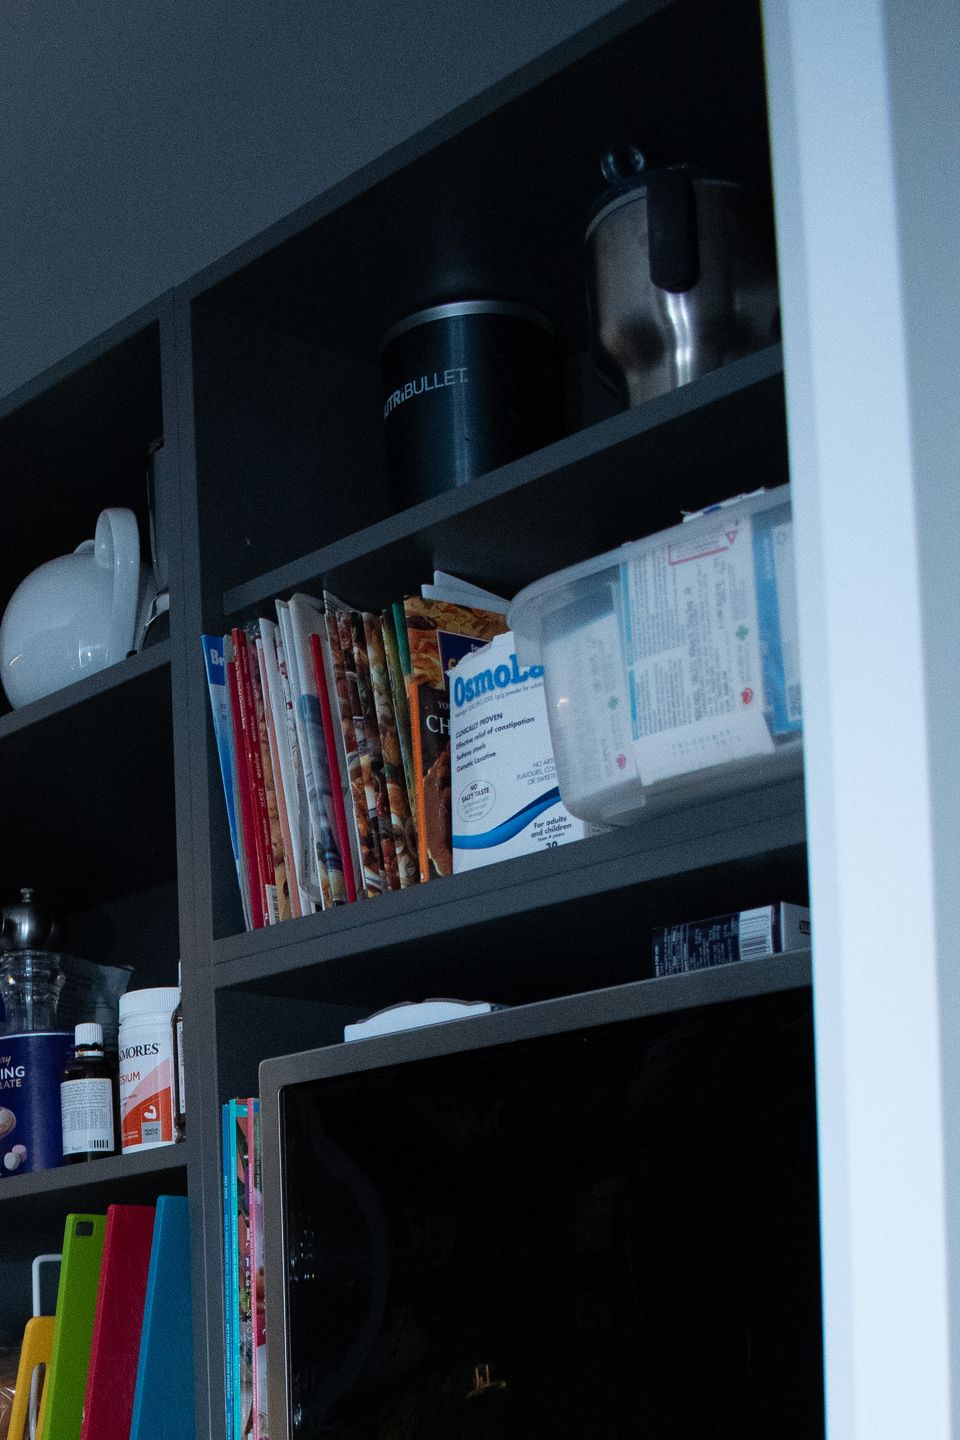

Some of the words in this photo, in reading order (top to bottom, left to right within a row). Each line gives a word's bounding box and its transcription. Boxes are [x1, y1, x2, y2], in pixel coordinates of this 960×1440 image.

[384, 367, 468, 420] UTRiBULLET
[454, 653, 544, 707] OsmoLa
[495, 716, 535, 733] constipation
[530, 830, 545, 839] and
[545, 823, 572, 835] children
[534, 822, 545, 830] For
[546, 815, 568, 827] adults
[119, 1043, 159, 1062] MORES
